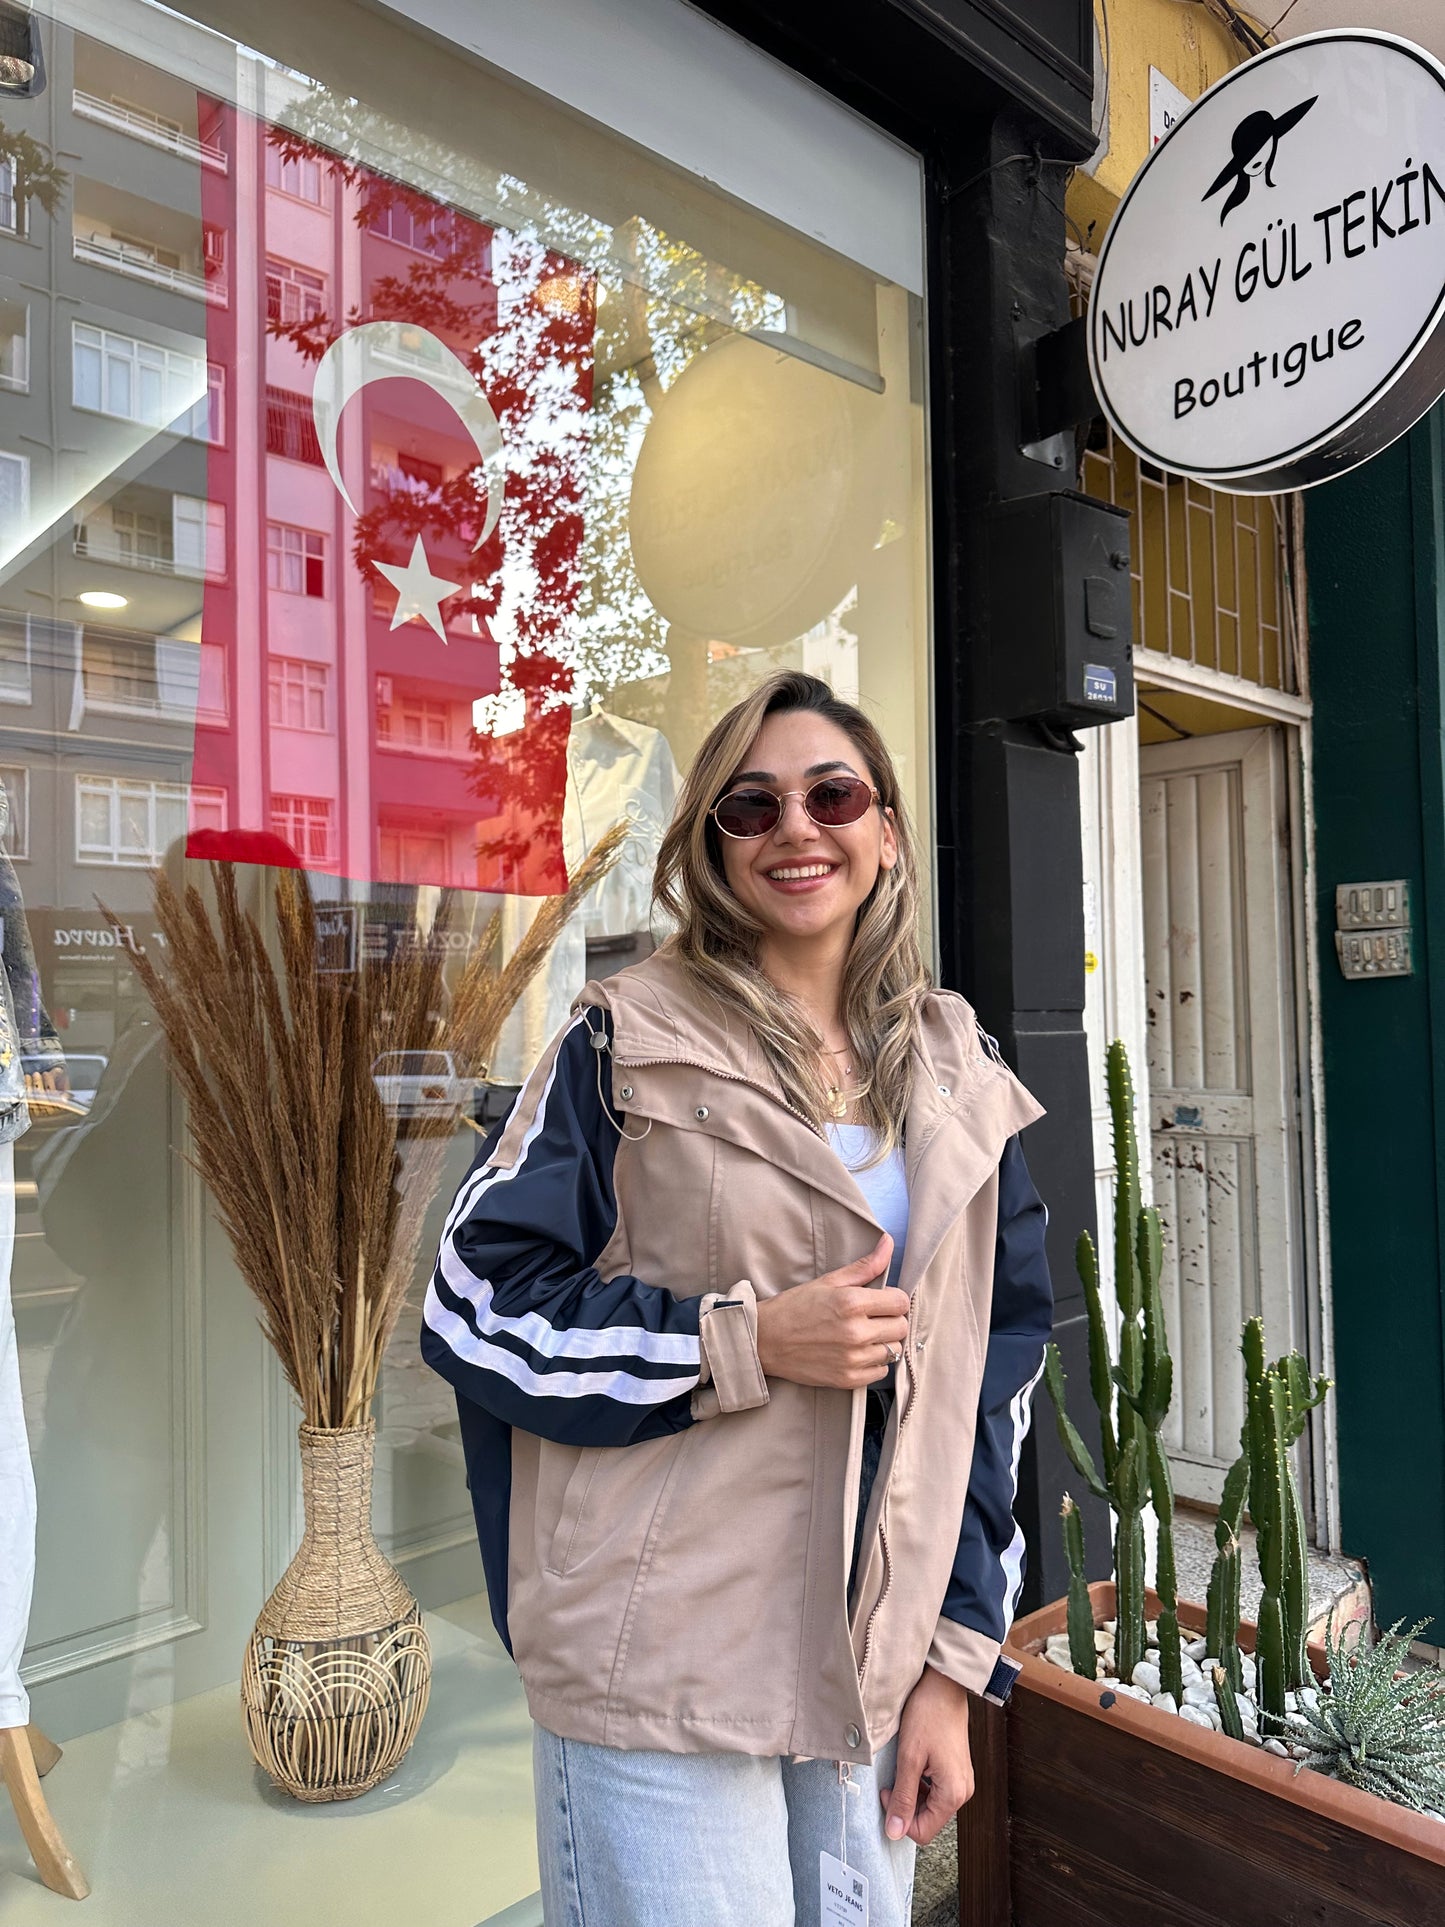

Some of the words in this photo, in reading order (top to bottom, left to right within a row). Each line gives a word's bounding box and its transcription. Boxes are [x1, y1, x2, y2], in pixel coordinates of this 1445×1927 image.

[1102, 258, 1221, 362] NURAY
[1094, 681, 1107, 691] SU
[827, 1882, 843, 1898] VETO
[845, 1895, 863, 1912] JEANS
